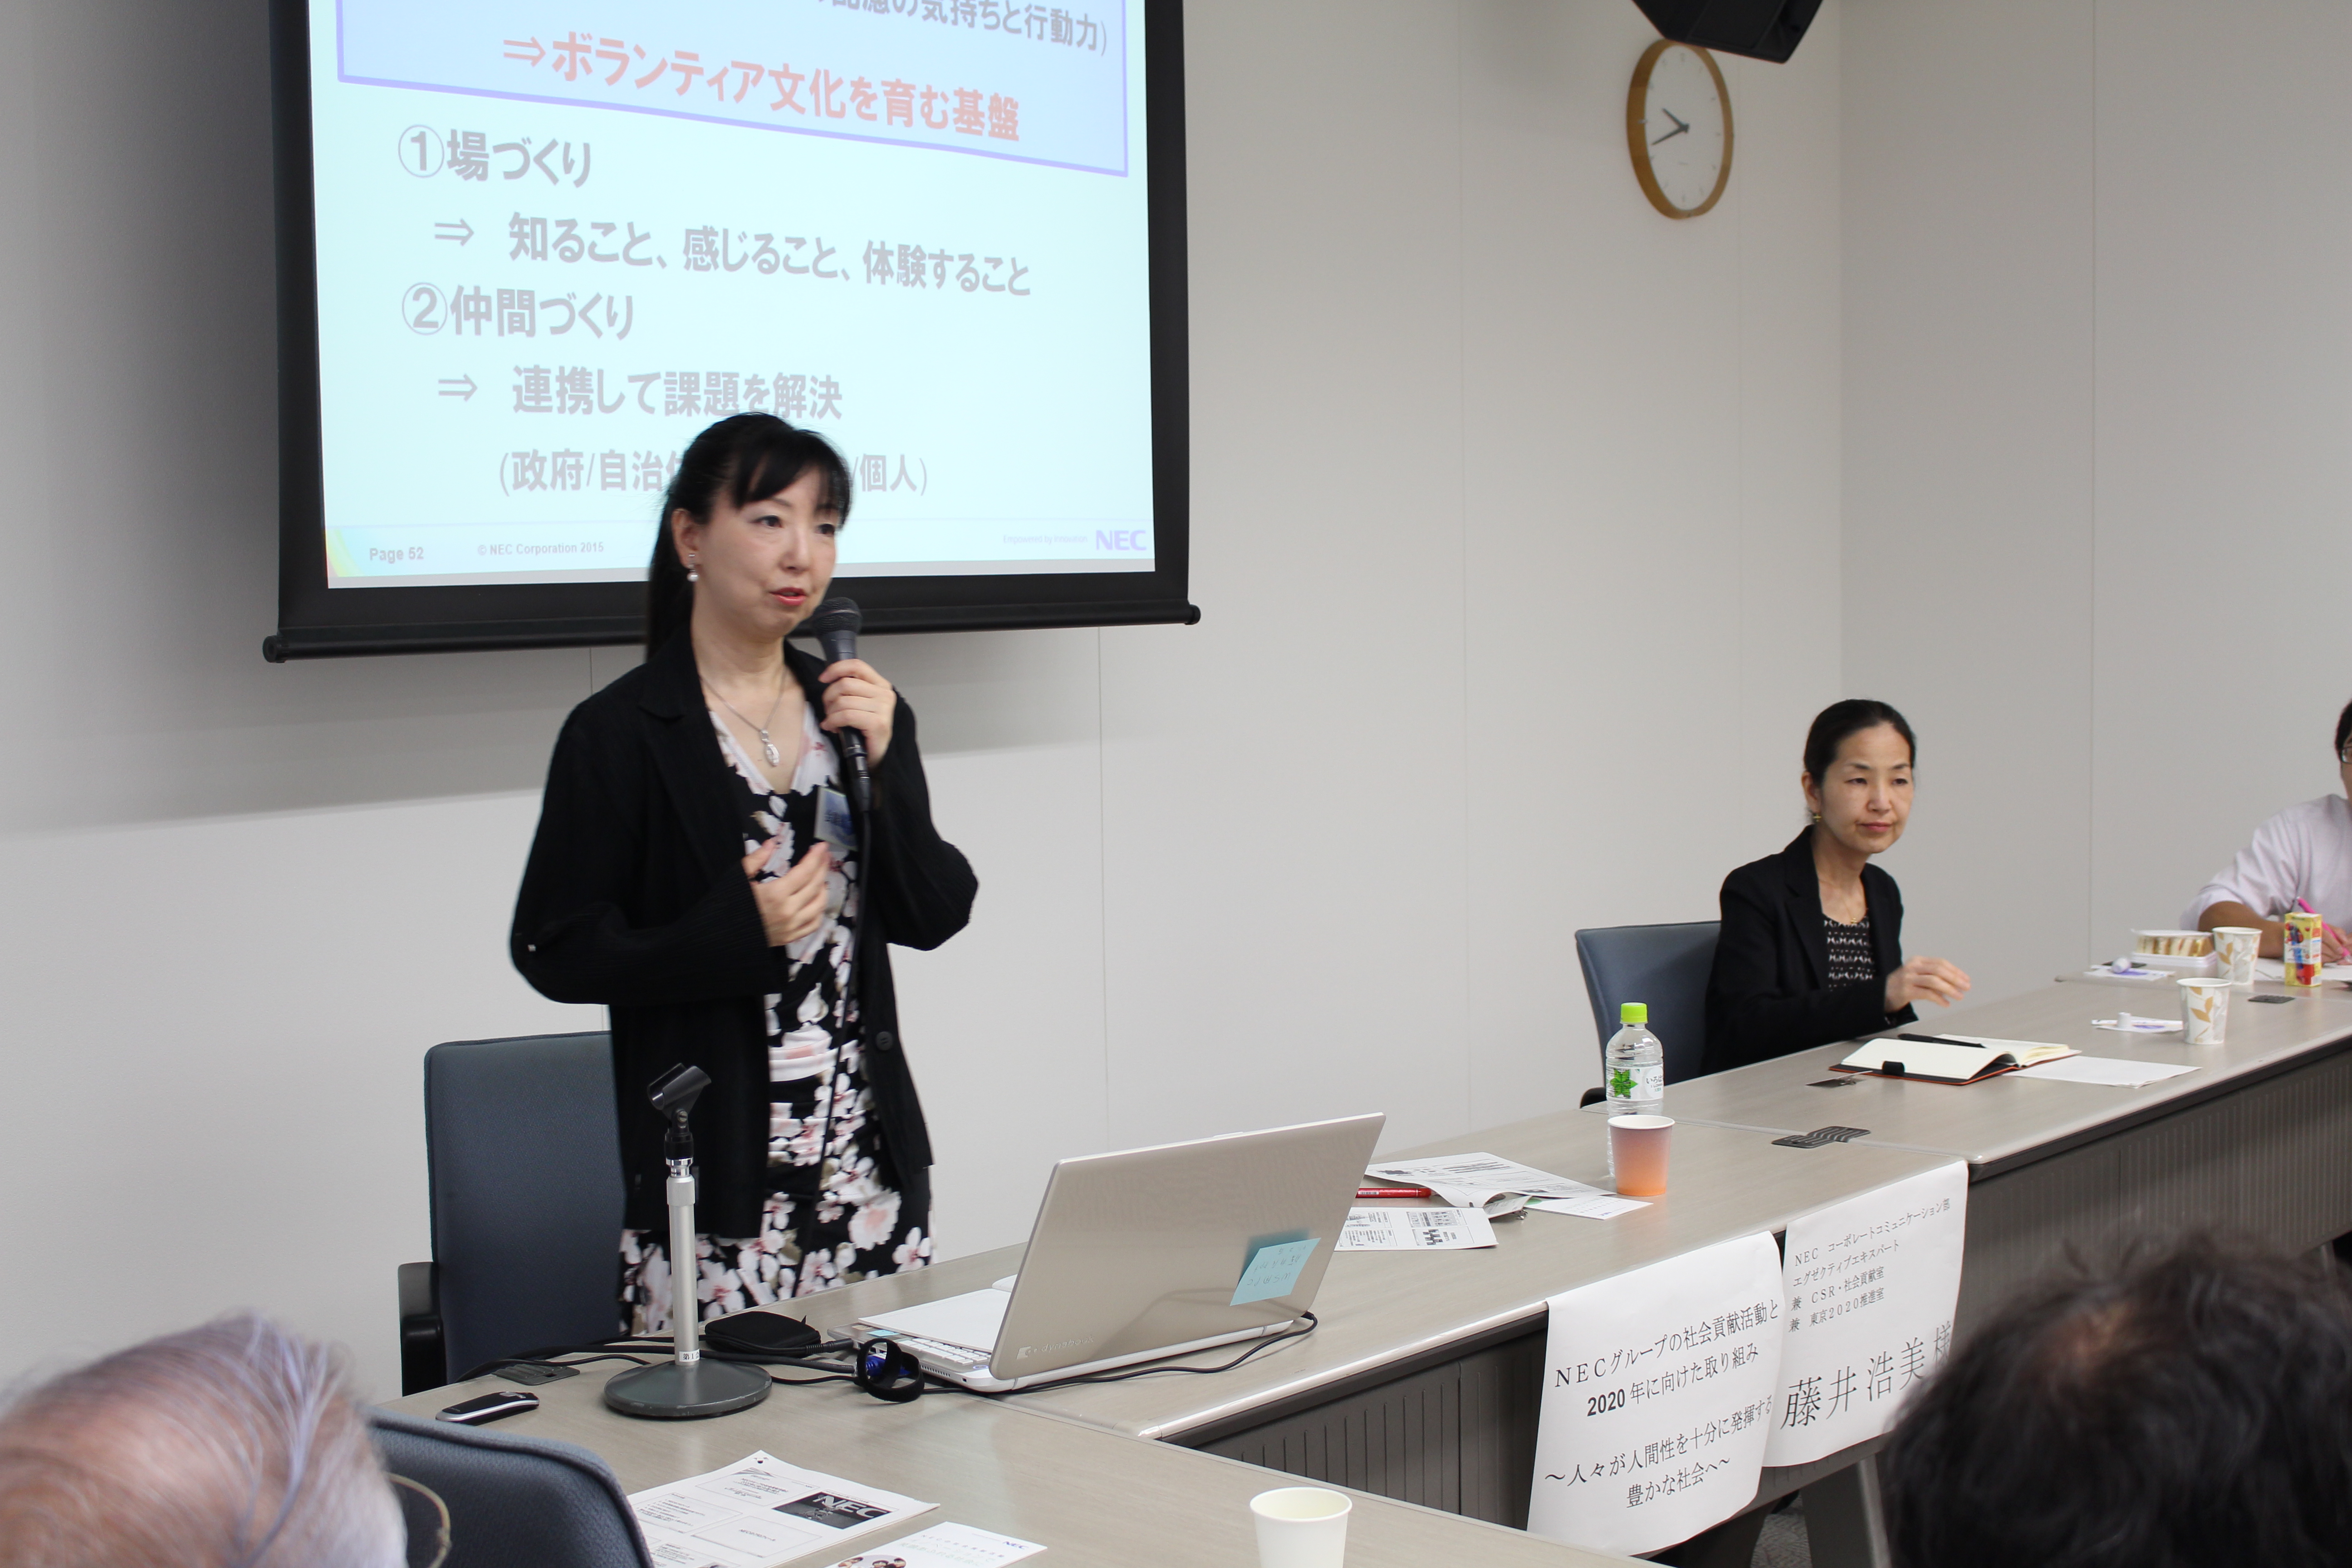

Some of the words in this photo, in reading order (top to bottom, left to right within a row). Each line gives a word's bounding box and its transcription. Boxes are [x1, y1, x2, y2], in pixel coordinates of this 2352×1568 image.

[552, 31, 1019, 141] ボランティア文化を育む基盤
[509, 211, 1031, 296] 知ること、感じること、体験すること
[513, 364, 843, 420] 連携して課題を解決
[490, 544, 513, 555] NEC
[516, 543, 578, 556] Corporation
[580, 542, 604, 553] 2015
[1096, 530, 1147, 551] NEC
[369, 548, 403, 564] Page
[408, 547, 425, 560] 52
[1793, 1240, 1899, 1287] エグゼクティブエキスパート
[1795, 1248, 1819, 1267] NEC
[1041, 1336, 1094, 1353] dynabook
[1555, 1299, 1779, 1387] NECグループの社会貢献活動と
[813, 1494, 888, 1519] NEC
